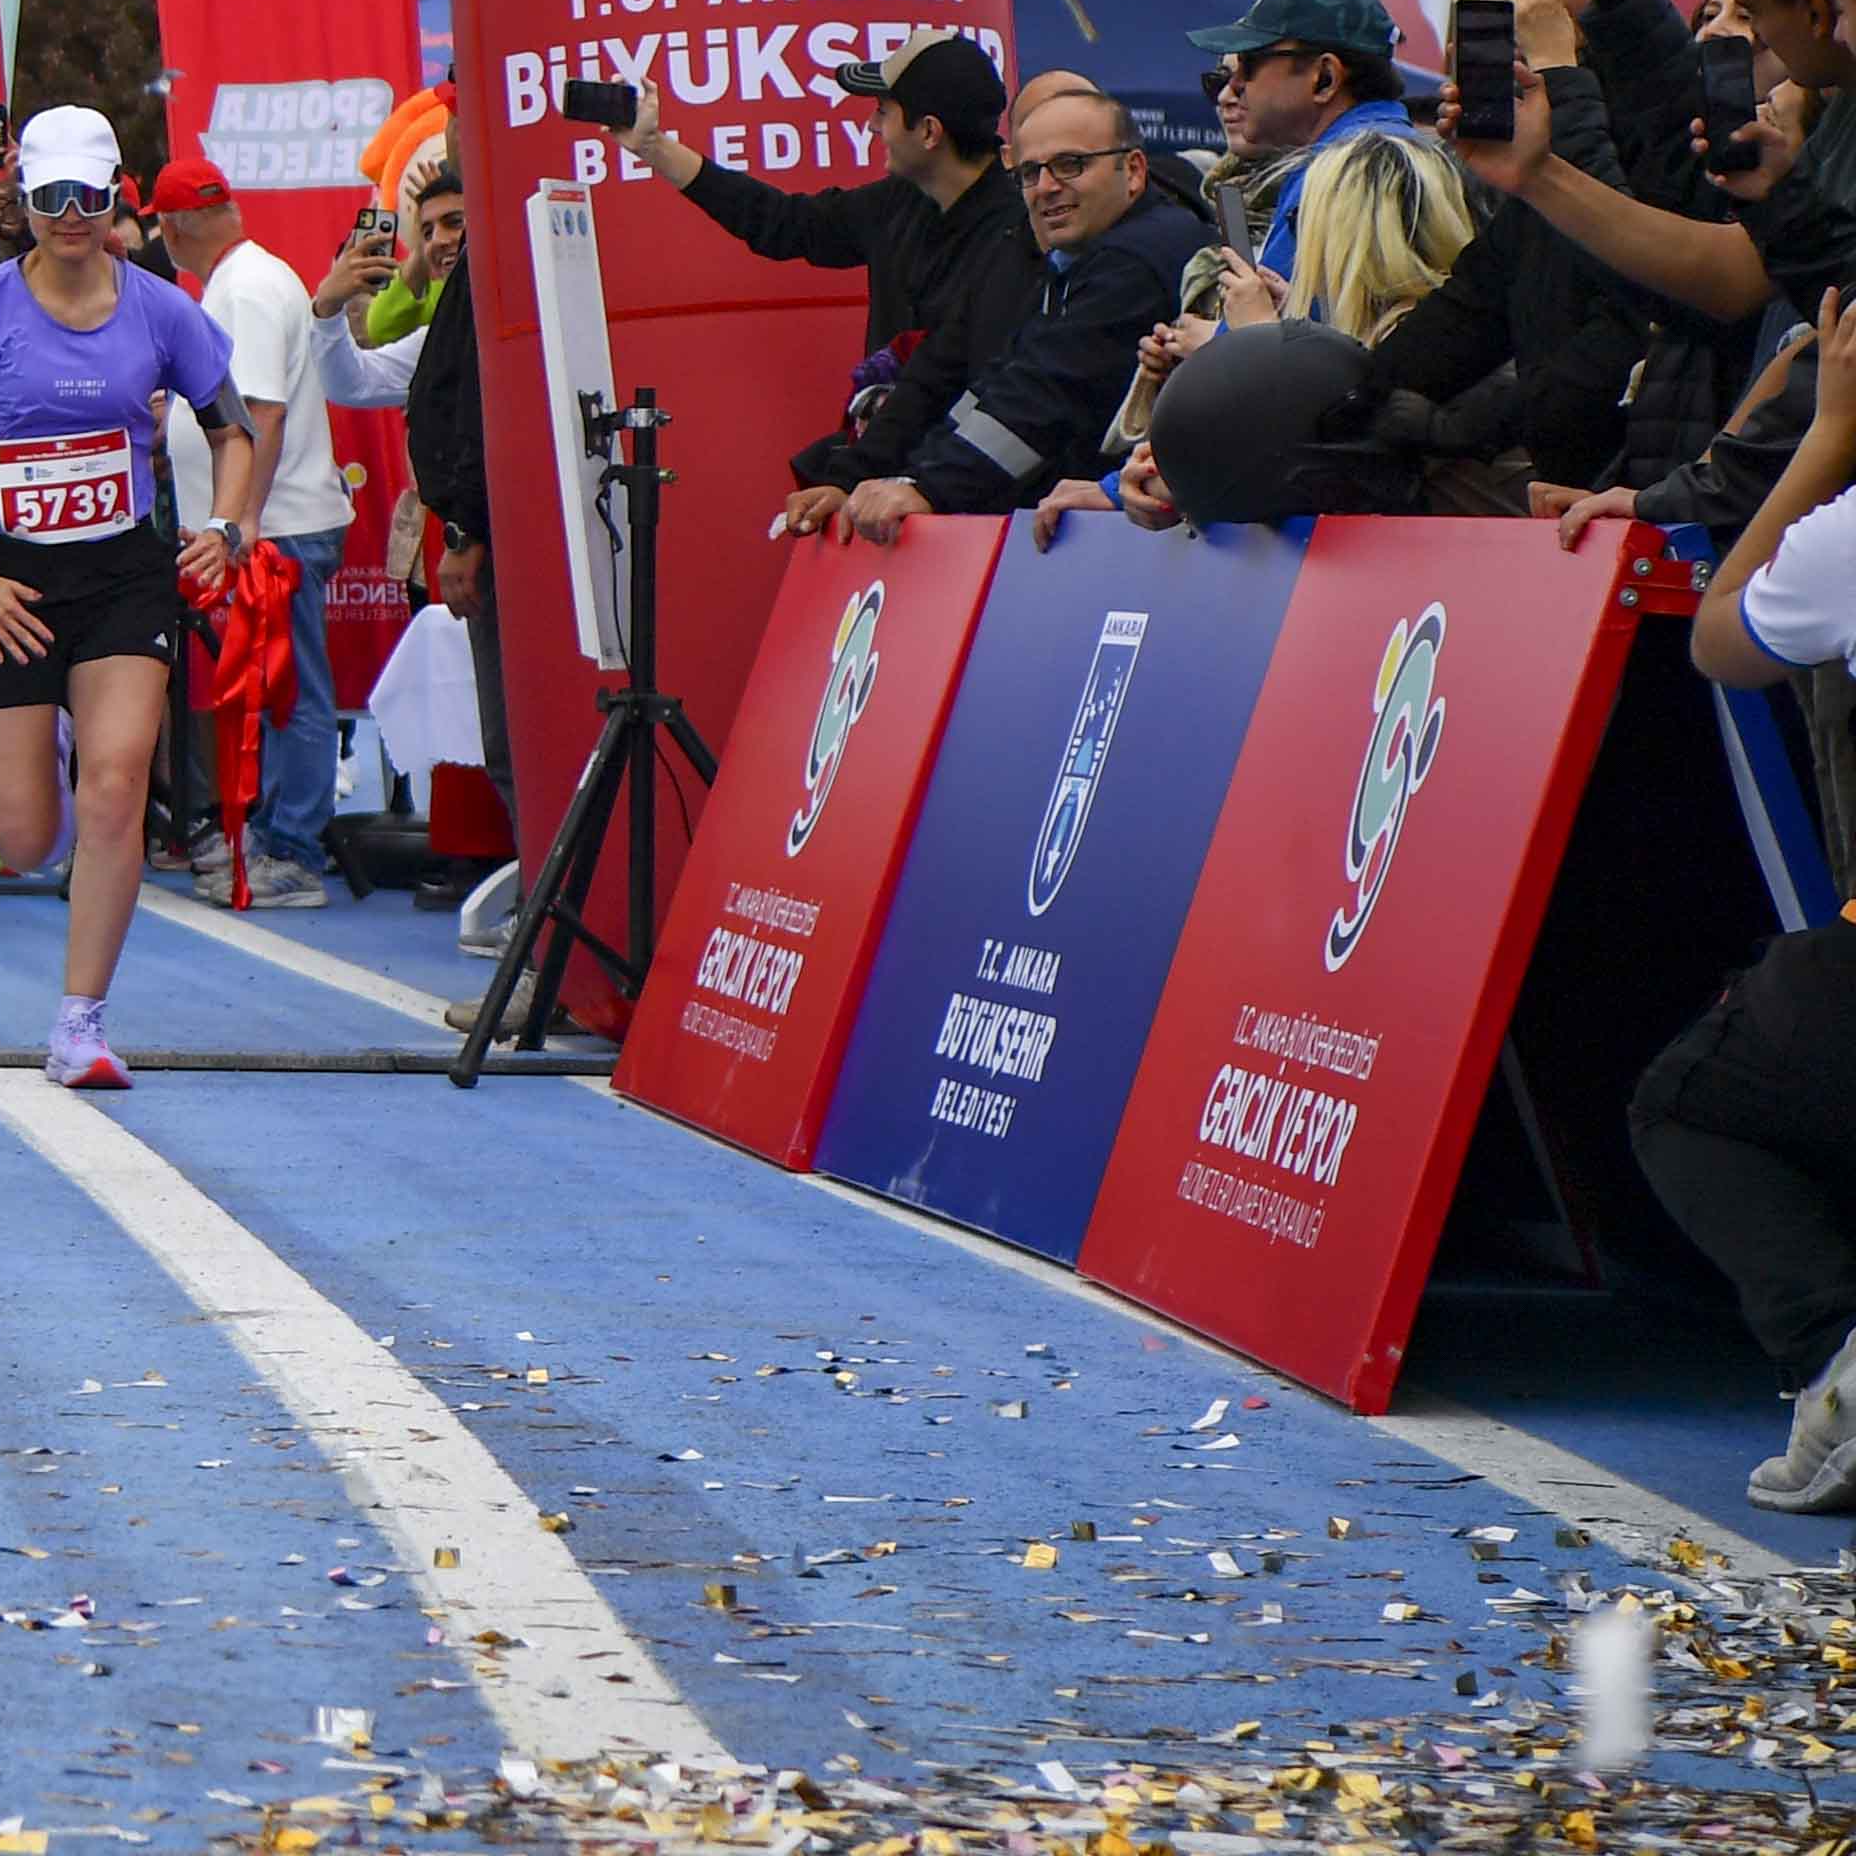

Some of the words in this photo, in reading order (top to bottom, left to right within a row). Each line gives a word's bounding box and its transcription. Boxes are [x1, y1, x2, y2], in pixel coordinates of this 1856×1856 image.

[16, 479, 119, 528] 5739
[976, 938, 1004, 982] T.C.
[1000, 944, 1061, 995] ANKARA
[930, 1077, 1017, 1139] BELEDİYESİ
[1268, 1086, 1315, 1170] VE
[1291, 1092, 1359, 1186] SPOR
